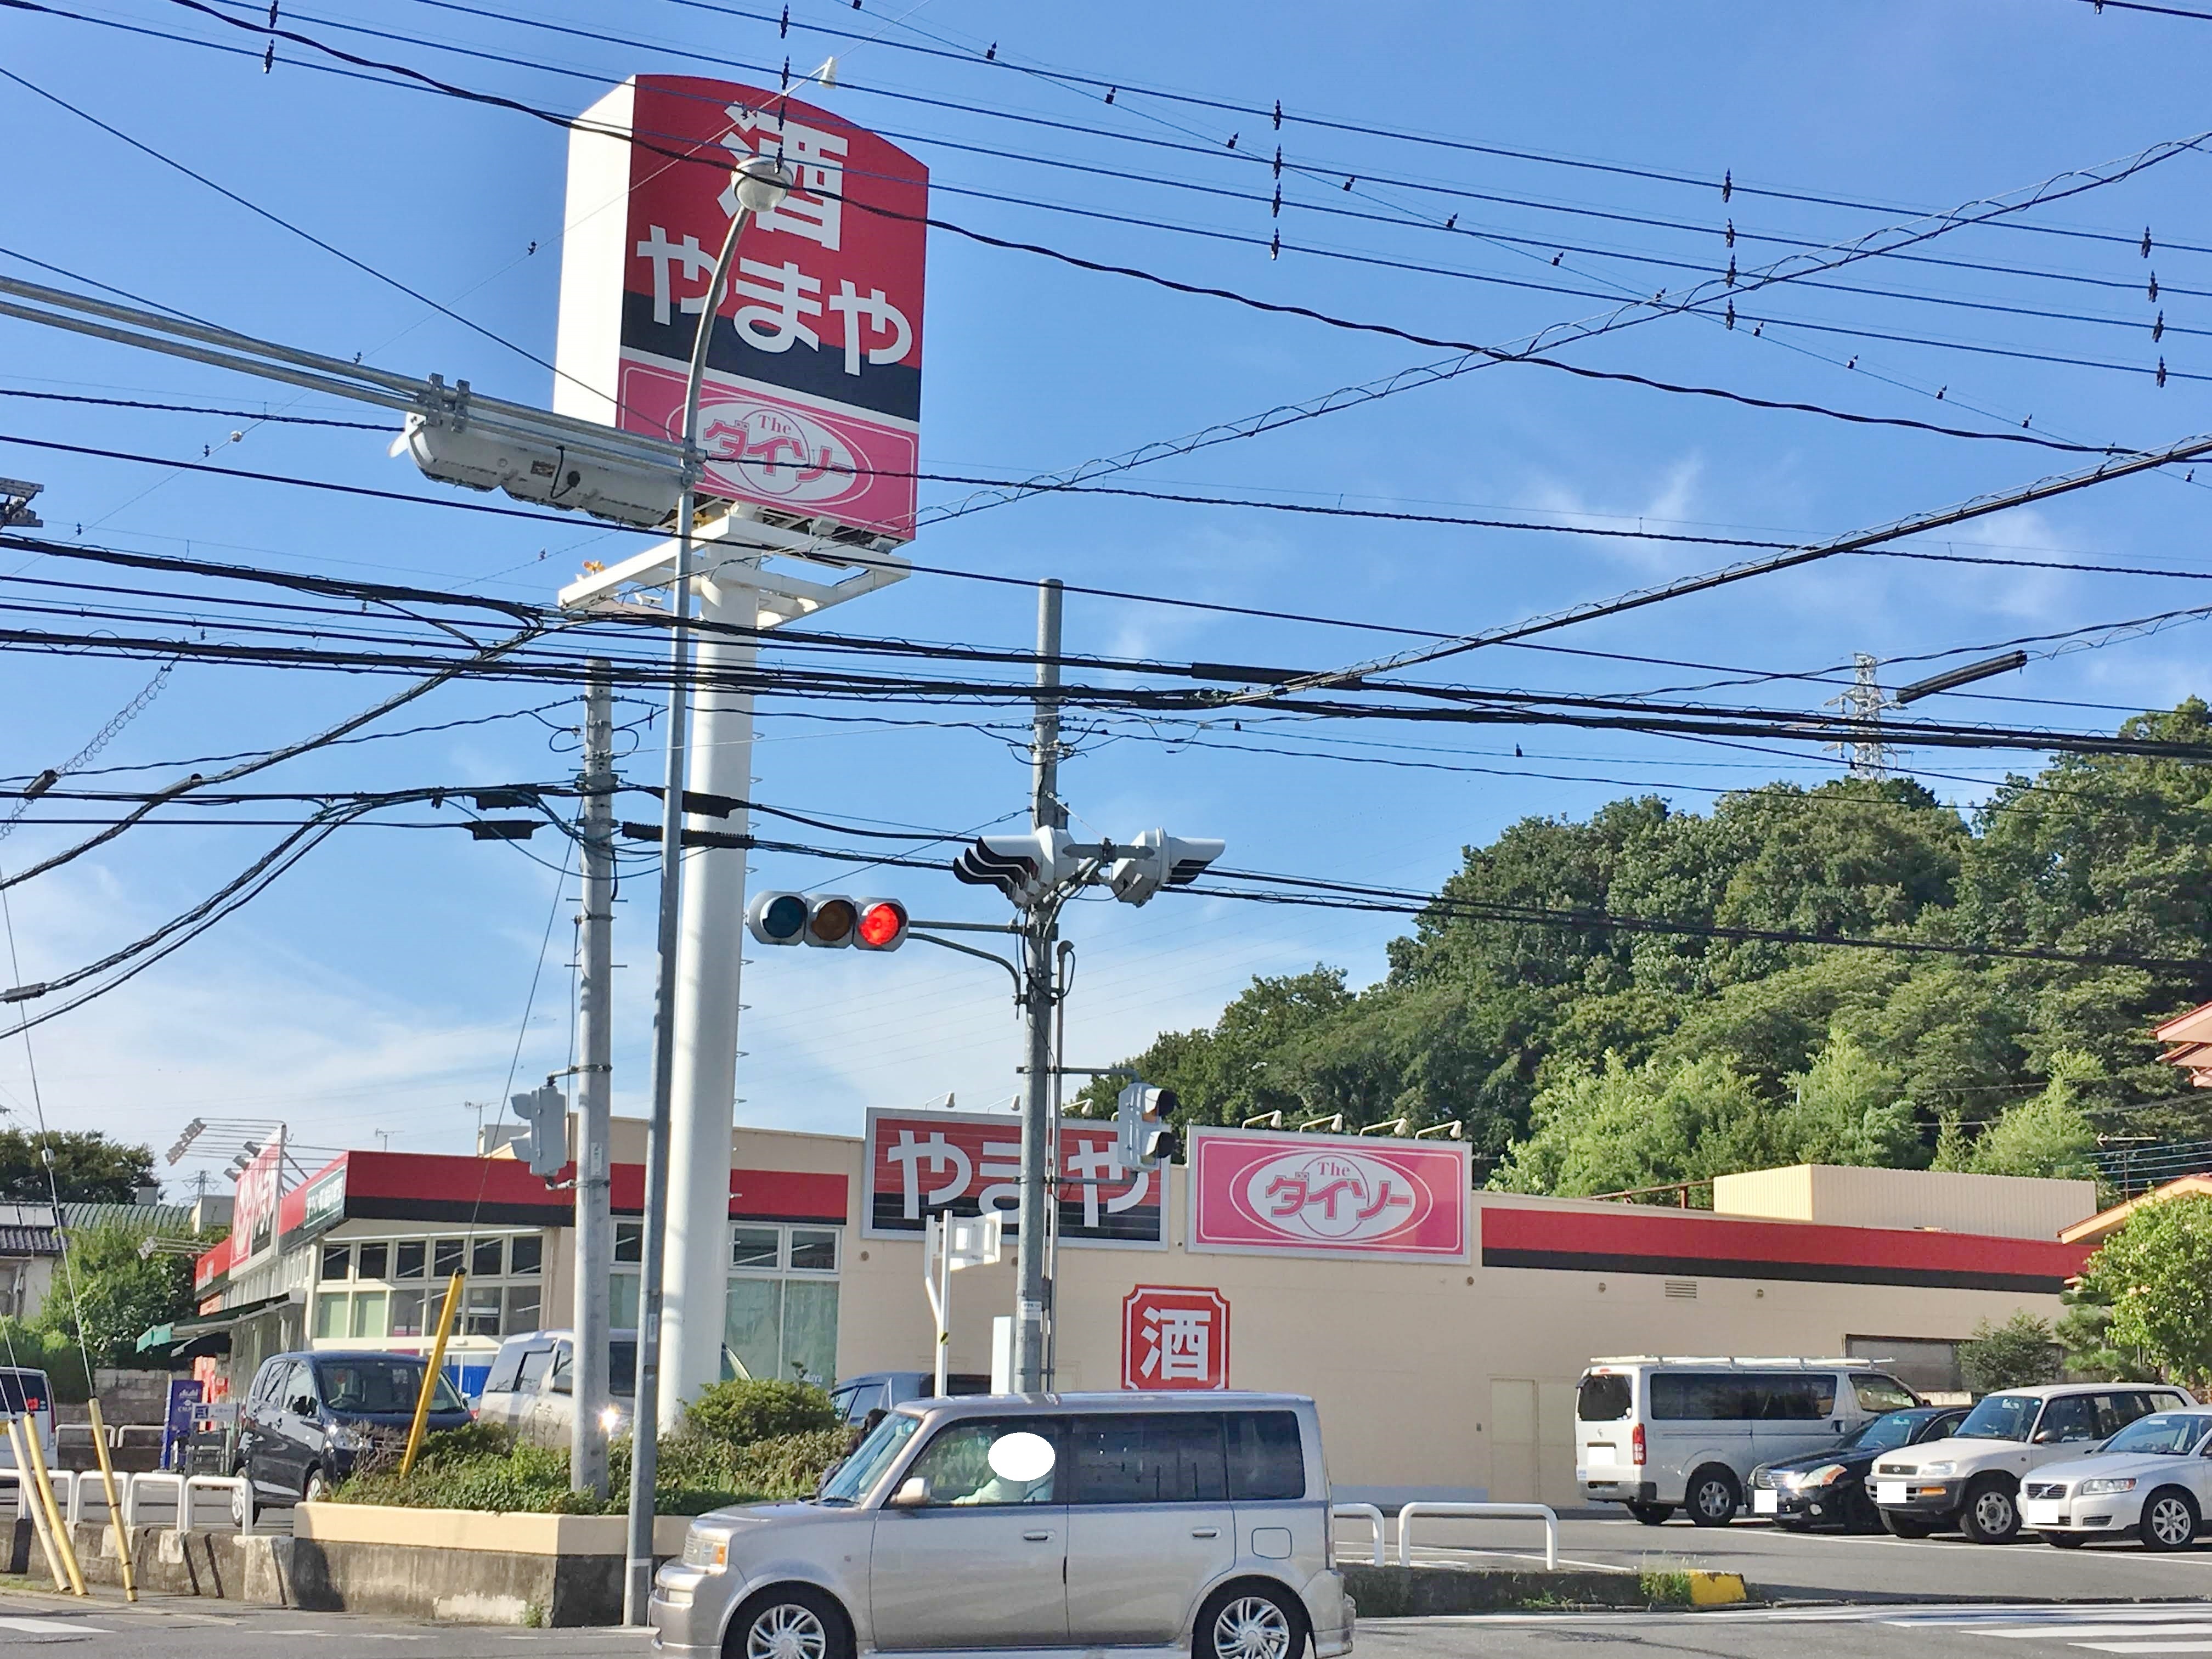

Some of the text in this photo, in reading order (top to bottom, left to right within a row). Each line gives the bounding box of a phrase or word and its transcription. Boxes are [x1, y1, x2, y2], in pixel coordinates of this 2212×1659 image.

[717, 100, 848, 251] 酒
[636, 224, 913, 376] やまや
[704, 419, 853, 482] ダイソー
[757, 414, 791, 435] The
[1266, 1172, 1412, 1221] ダイソー
[1317, 1161, 1351, 1177] The
[1140, 1306, 1211, 1381] 酒
